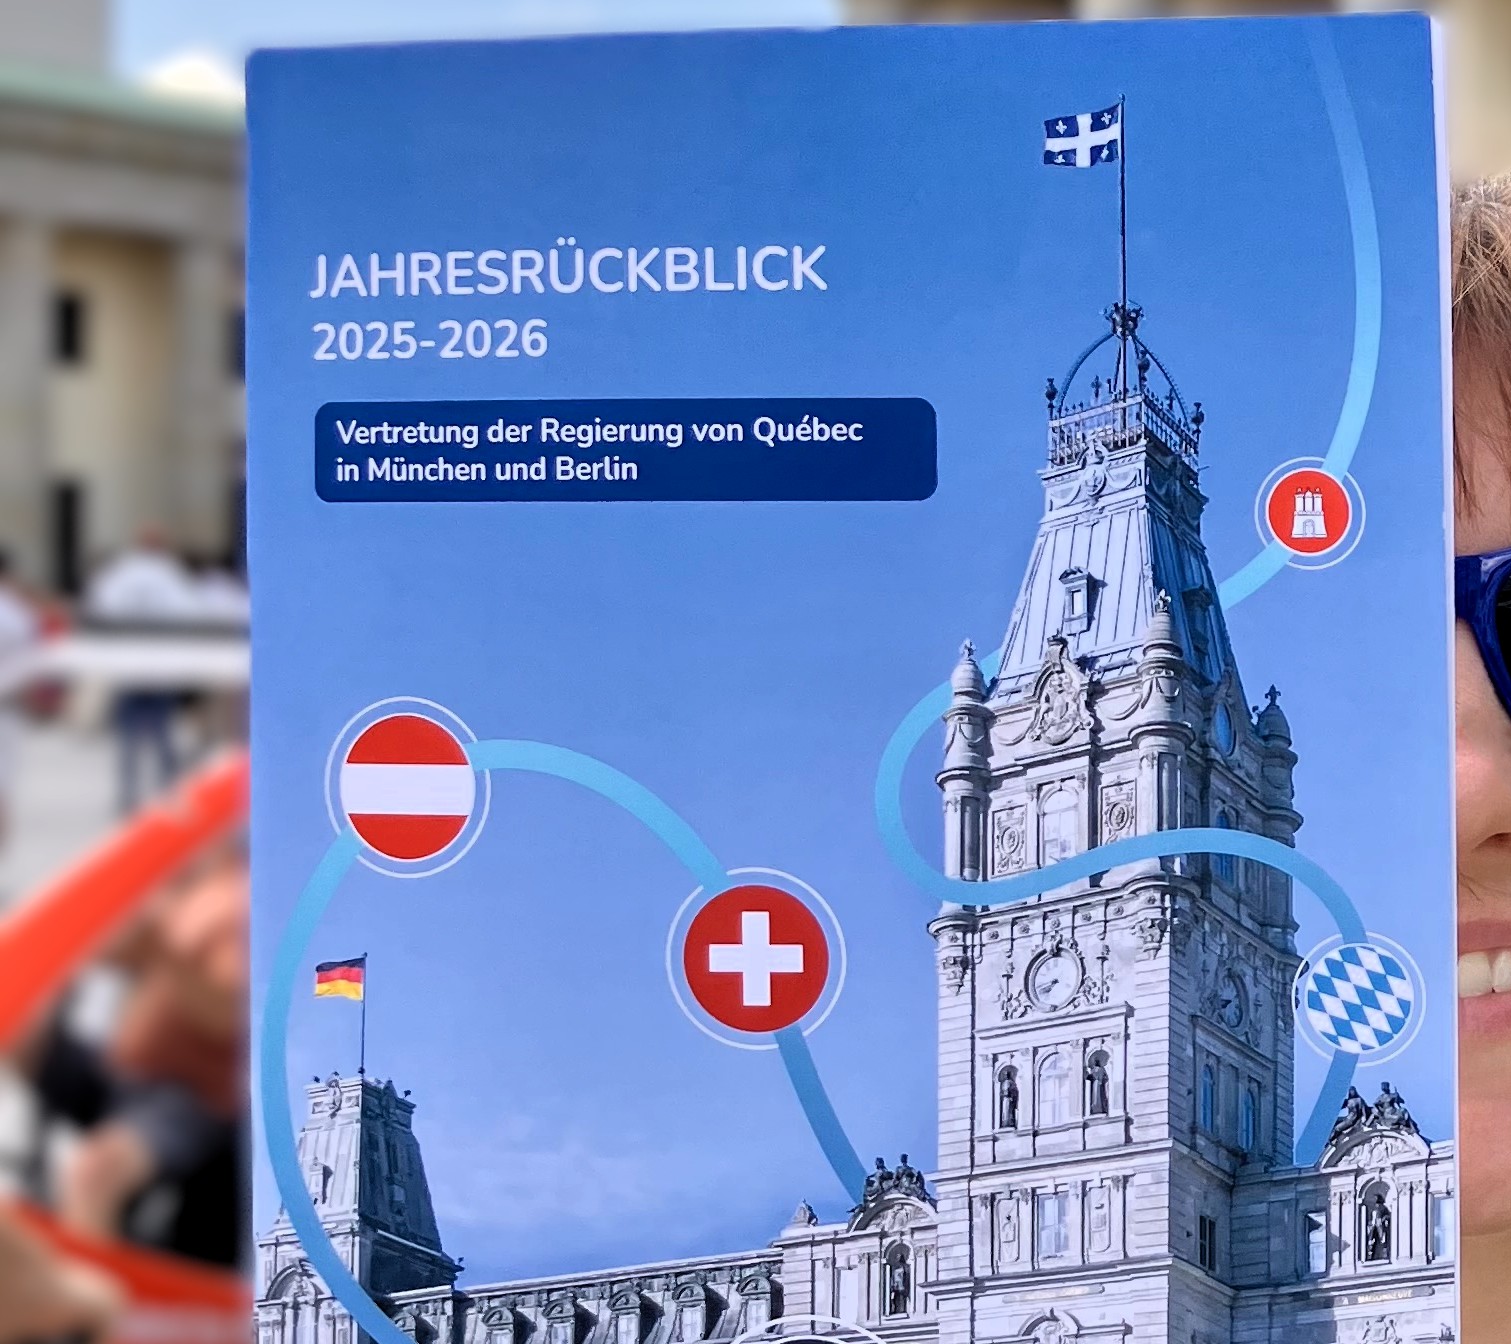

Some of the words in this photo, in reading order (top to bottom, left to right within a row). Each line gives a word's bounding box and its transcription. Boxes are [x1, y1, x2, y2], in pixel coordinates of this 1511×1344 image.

[309, 236, 828, 299] JAHRESRÜCKBLICK
[313, 319, 548, 361] 2025-2026
[335, 419, 479, 449] Vertretung
[486, 418, 533, 443] der
[540, 417, 683, 449] Regierung
[691, 423, 744, 442] von
[753, 415, 864, 448] Québec
[336, 457, 360, 482] in
[368, 456, 487, 482] München
[495, 456, 547, 481] und
[555, 455, 638, 481] Berlin
